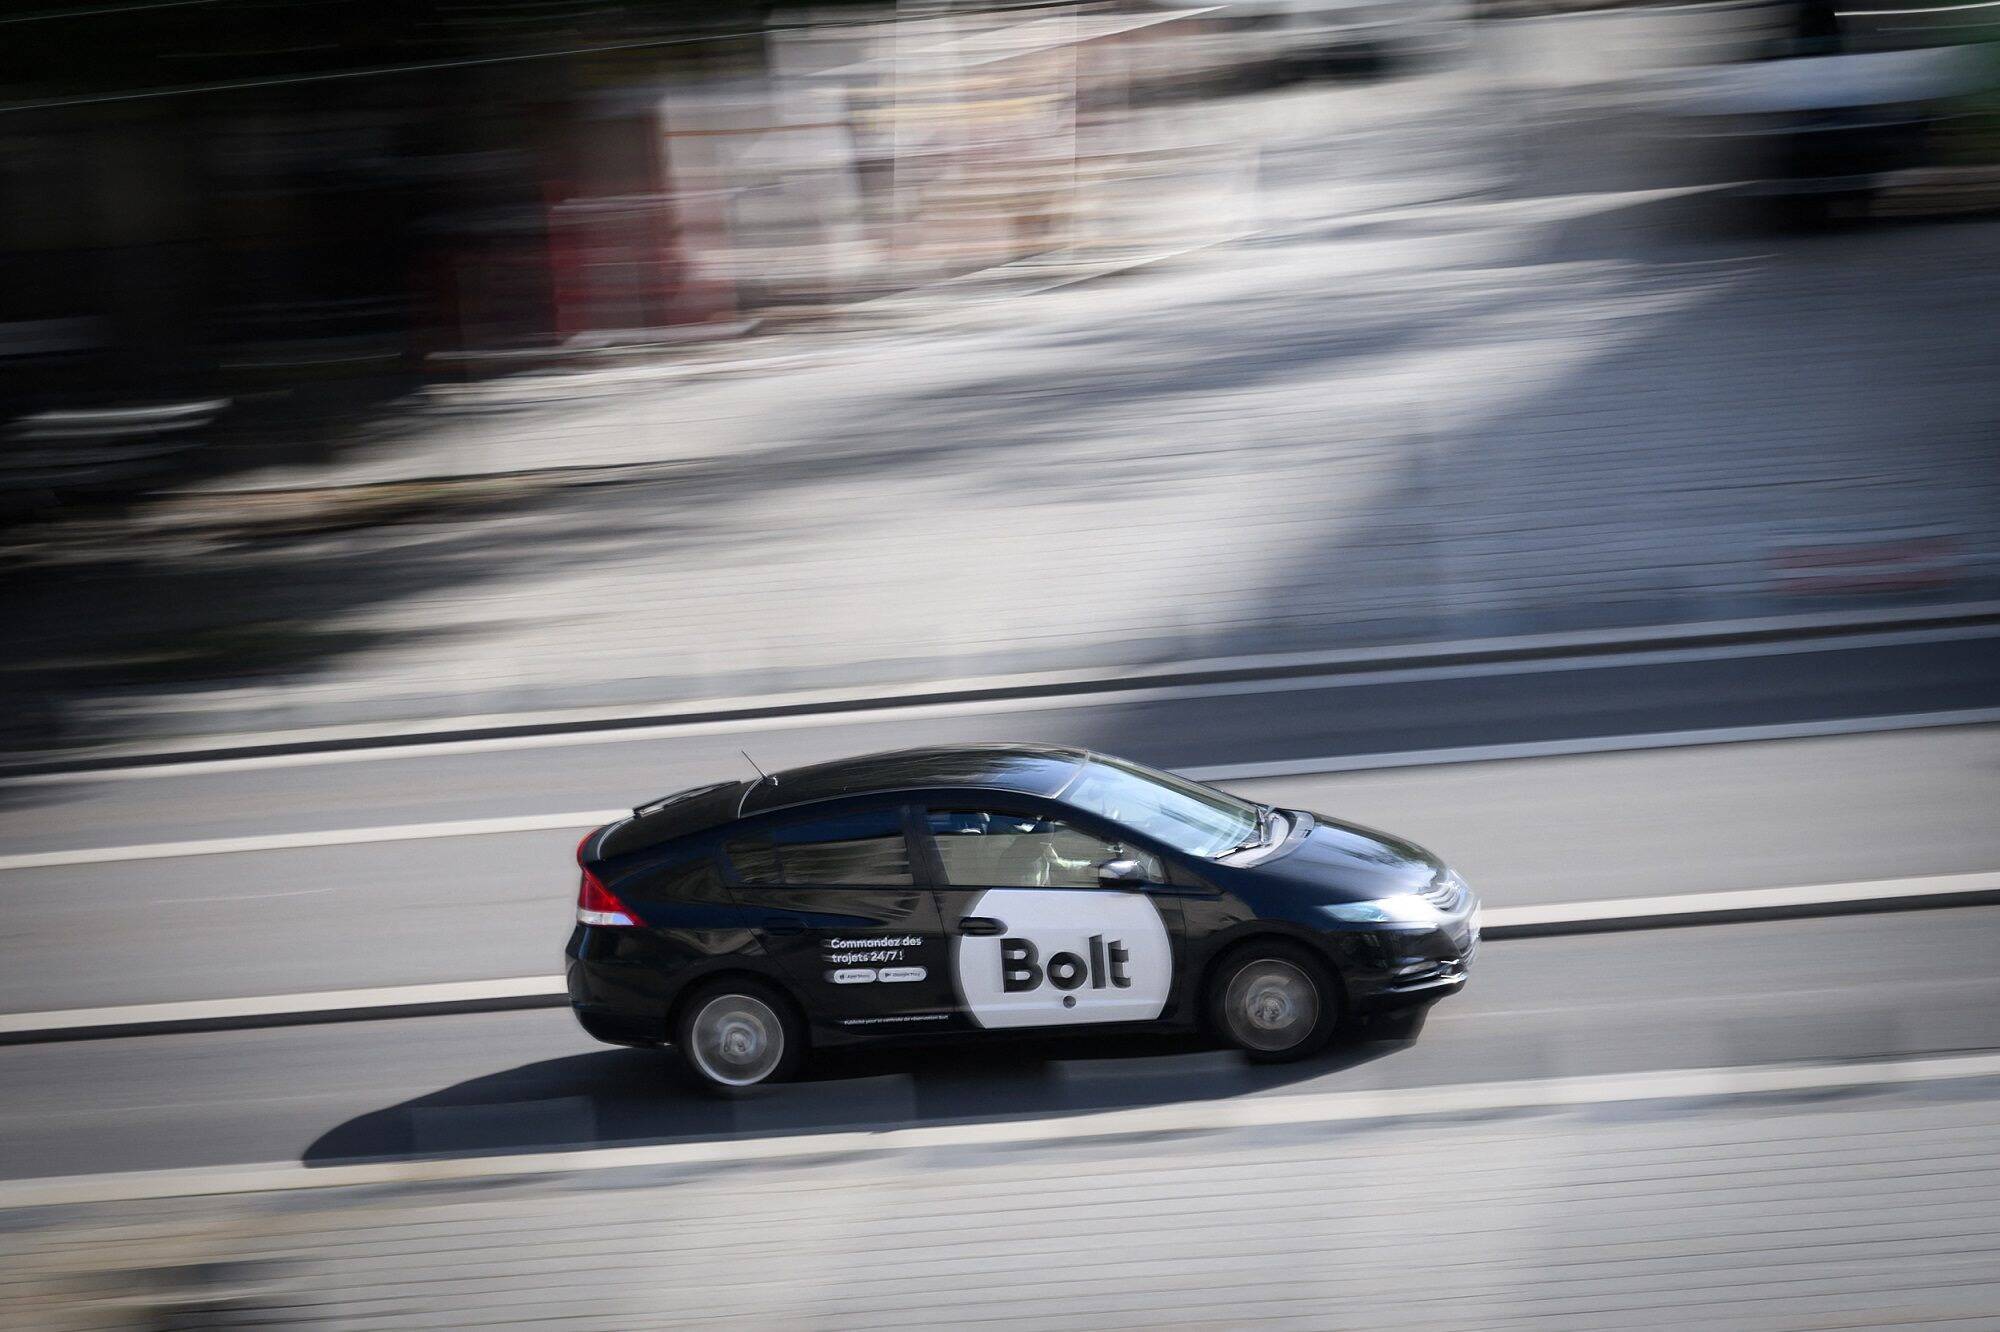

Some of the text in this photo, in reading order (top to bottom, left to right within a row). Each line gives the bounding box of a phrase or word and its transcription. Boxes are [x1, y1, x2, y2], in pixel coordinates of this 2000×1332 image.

[831, 935, 922, 949] Commandez des
[832, 952, 869, 965] trajets
[870, 950, 897, 962] 24/7
[1000, 934, 1131, 994] Bolt
